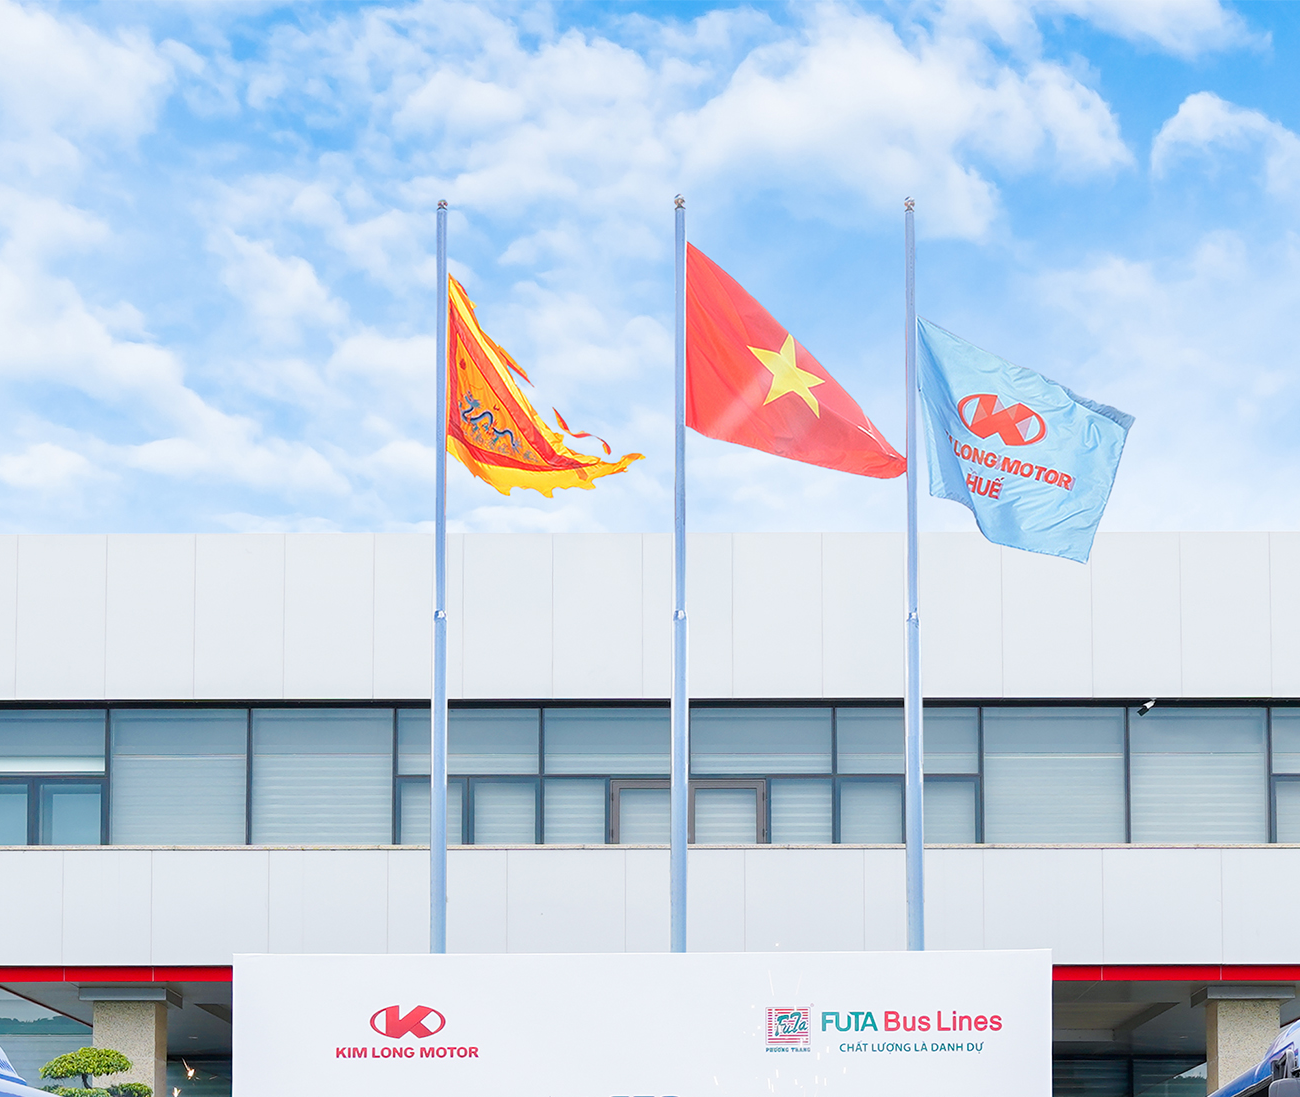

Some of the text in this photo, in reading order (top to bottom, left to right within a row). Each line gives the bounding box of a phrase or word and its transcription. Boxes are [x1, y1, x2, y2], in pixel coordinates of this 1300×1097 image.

[954, 440, 1074, 491] LONG MOTOR
[966, 472, 1004, 500] HUẾ
[821, 1010, 1003, 1032] FUTA Bus Lines
[335, 1047, 479, 1059] KIM LONG MOTOR
[839, 1040, 985, 1054] CHẤT LƯỢNG LÀ DANH DỰ
